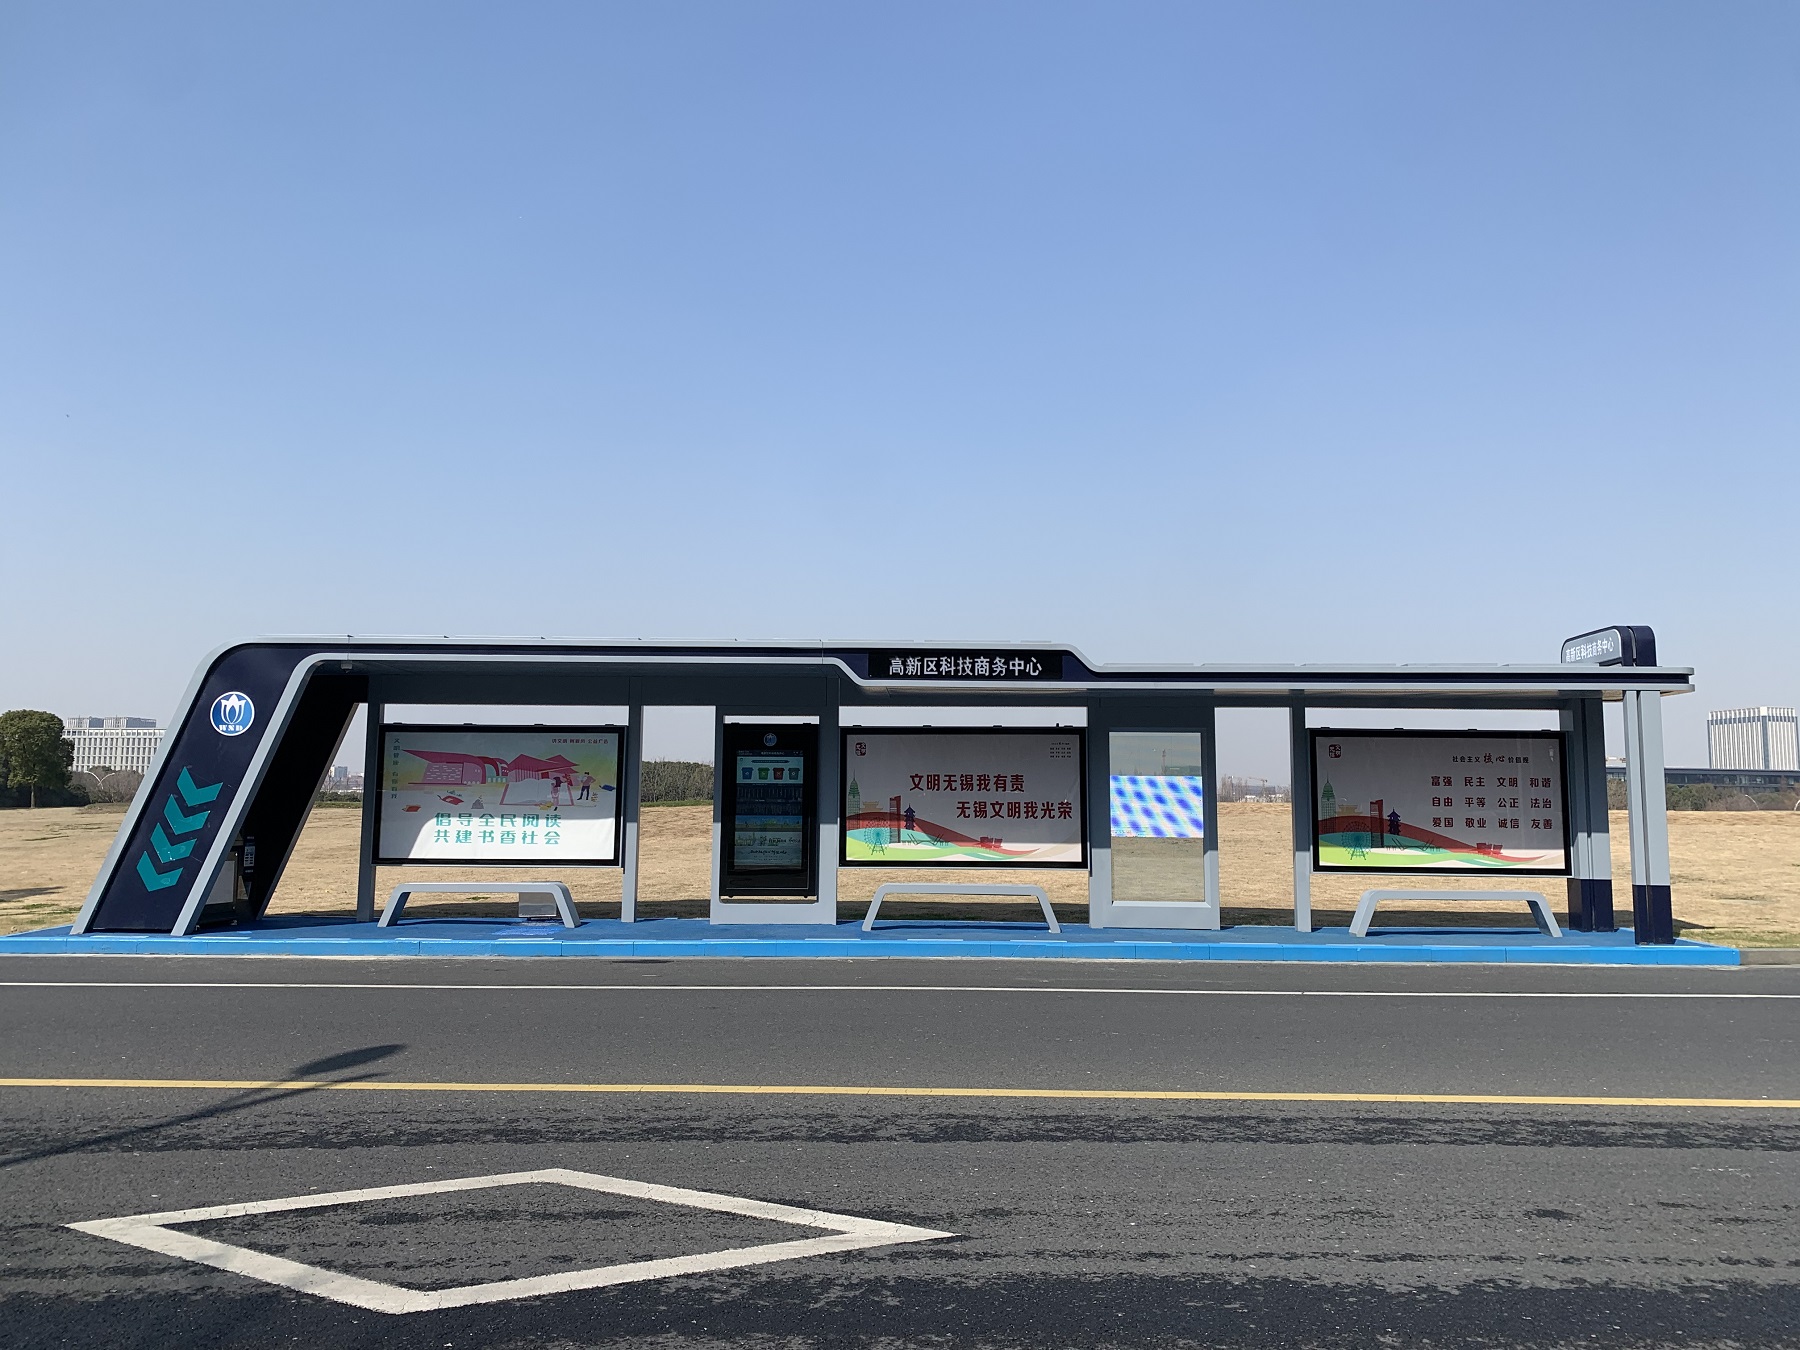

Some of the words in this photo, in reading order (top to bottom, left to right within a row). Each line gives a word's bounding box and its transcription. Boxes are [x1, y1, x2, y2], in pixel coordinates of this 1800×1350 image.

[889, 656, 1043, 677] 高新区科技商务中心
[909, 773, 1025, 793] 文明无锡我有责
[1431, 776, 1452, 787] 富强
[1464, 776, 1485, 787] 民主
[1496, 777, 1518, 788] 文明
[1529, 777, 1551, 788] 和谐
[956, 801, 1073, 820] 无锡文明我光荣
[1432, 796, 1453, 807] 自由
[1464, 797, 1486, 808] 平等
[1497, 797, 1519, 809] 公正
[1530, 798, 1552, 809] 法治
[434, 812, 562, 828] 倡导全民阅读
[1432, 817, 1454, 828] 爱国
[1465, 817, 1487, 829] 敬业
[1498, 818, 1520, 829] 诚信
[1530, 818, 1553, 830] 友善
[433, 829, 561, 845] 共建书香社会
